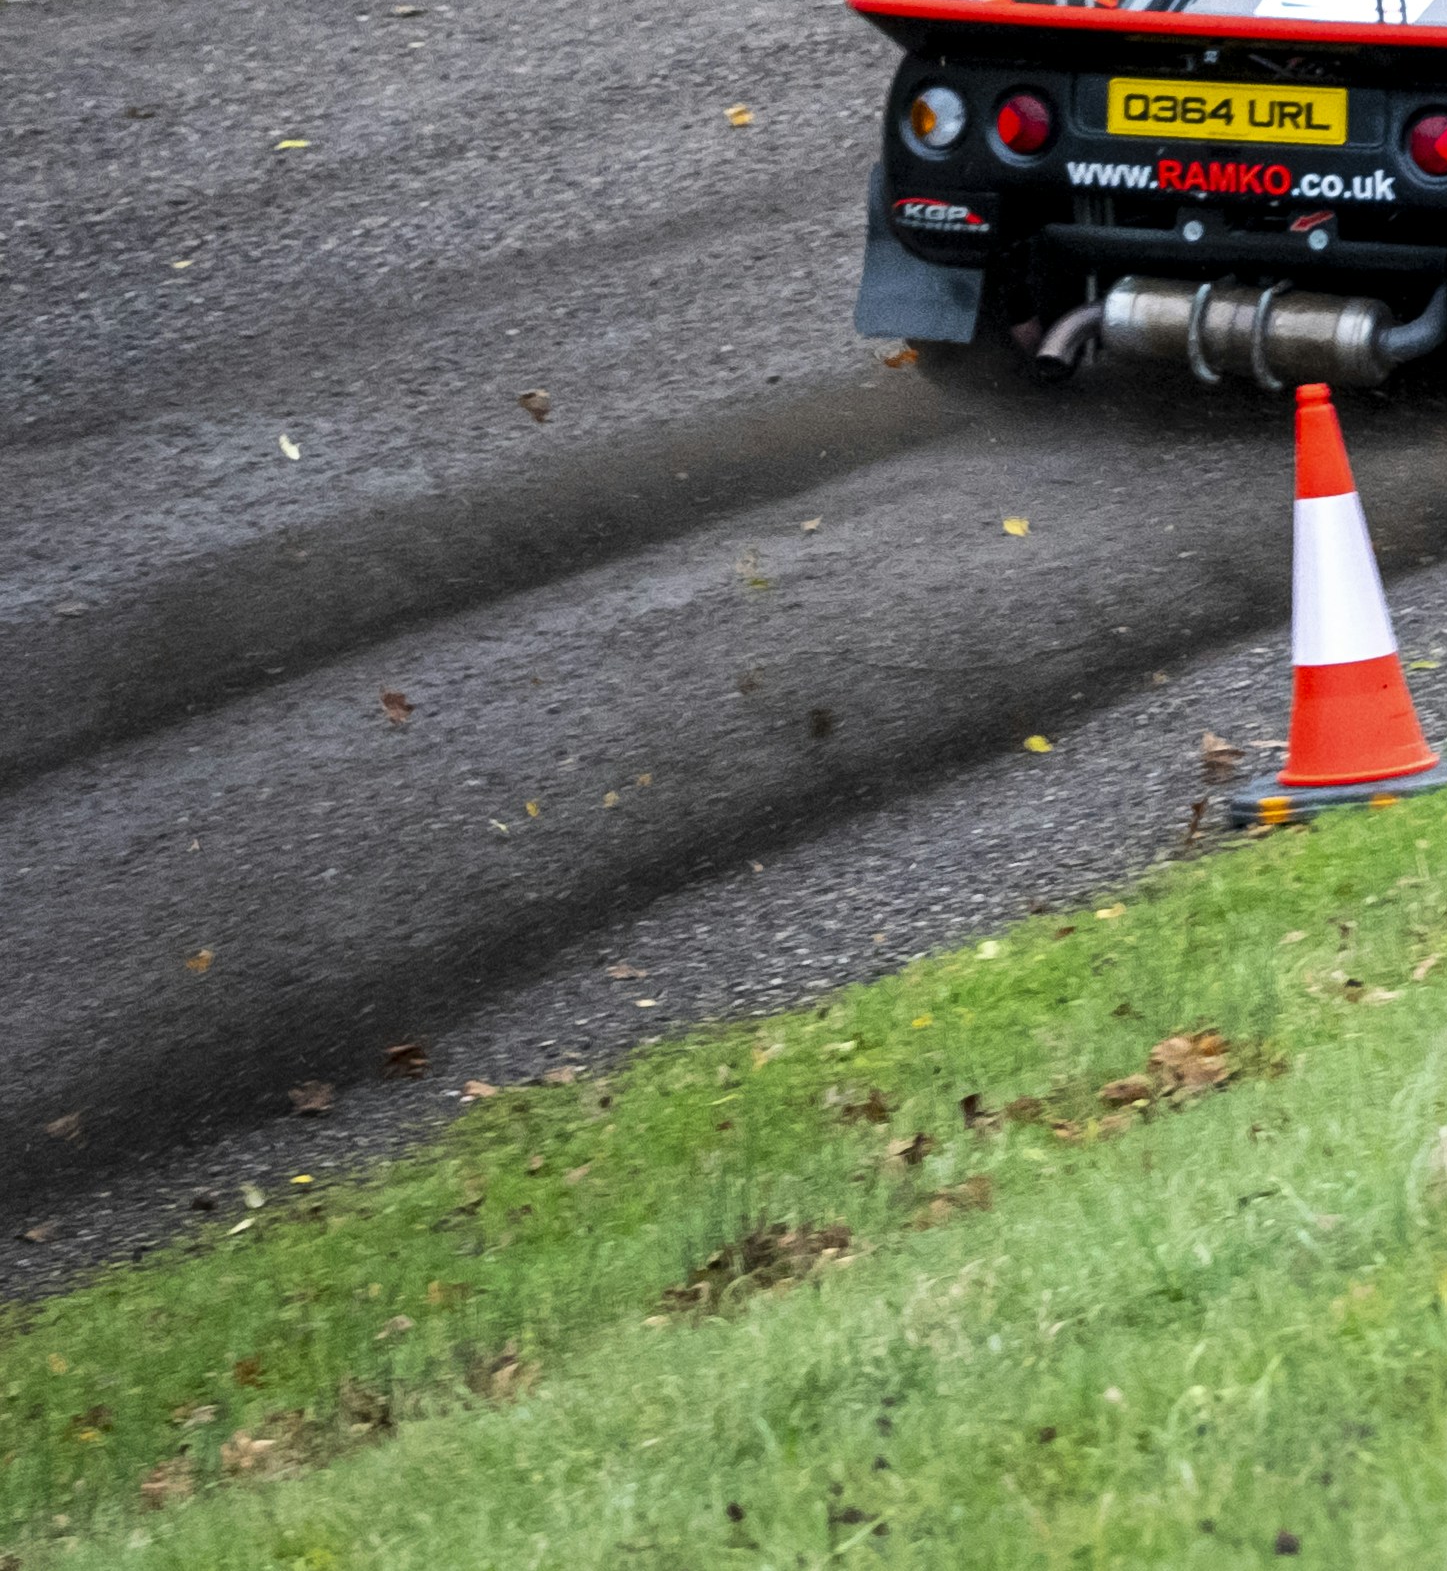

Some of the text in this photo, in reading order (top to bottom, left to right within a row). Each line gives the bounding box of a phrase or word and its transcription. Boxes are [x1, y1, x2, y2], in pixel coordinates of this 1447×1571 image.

[1248, 99, 1331, 131] URL
[1066, 159, 1396, 201] www.RAMKO.co.uk
[903, 203, 969, 221] KGP
